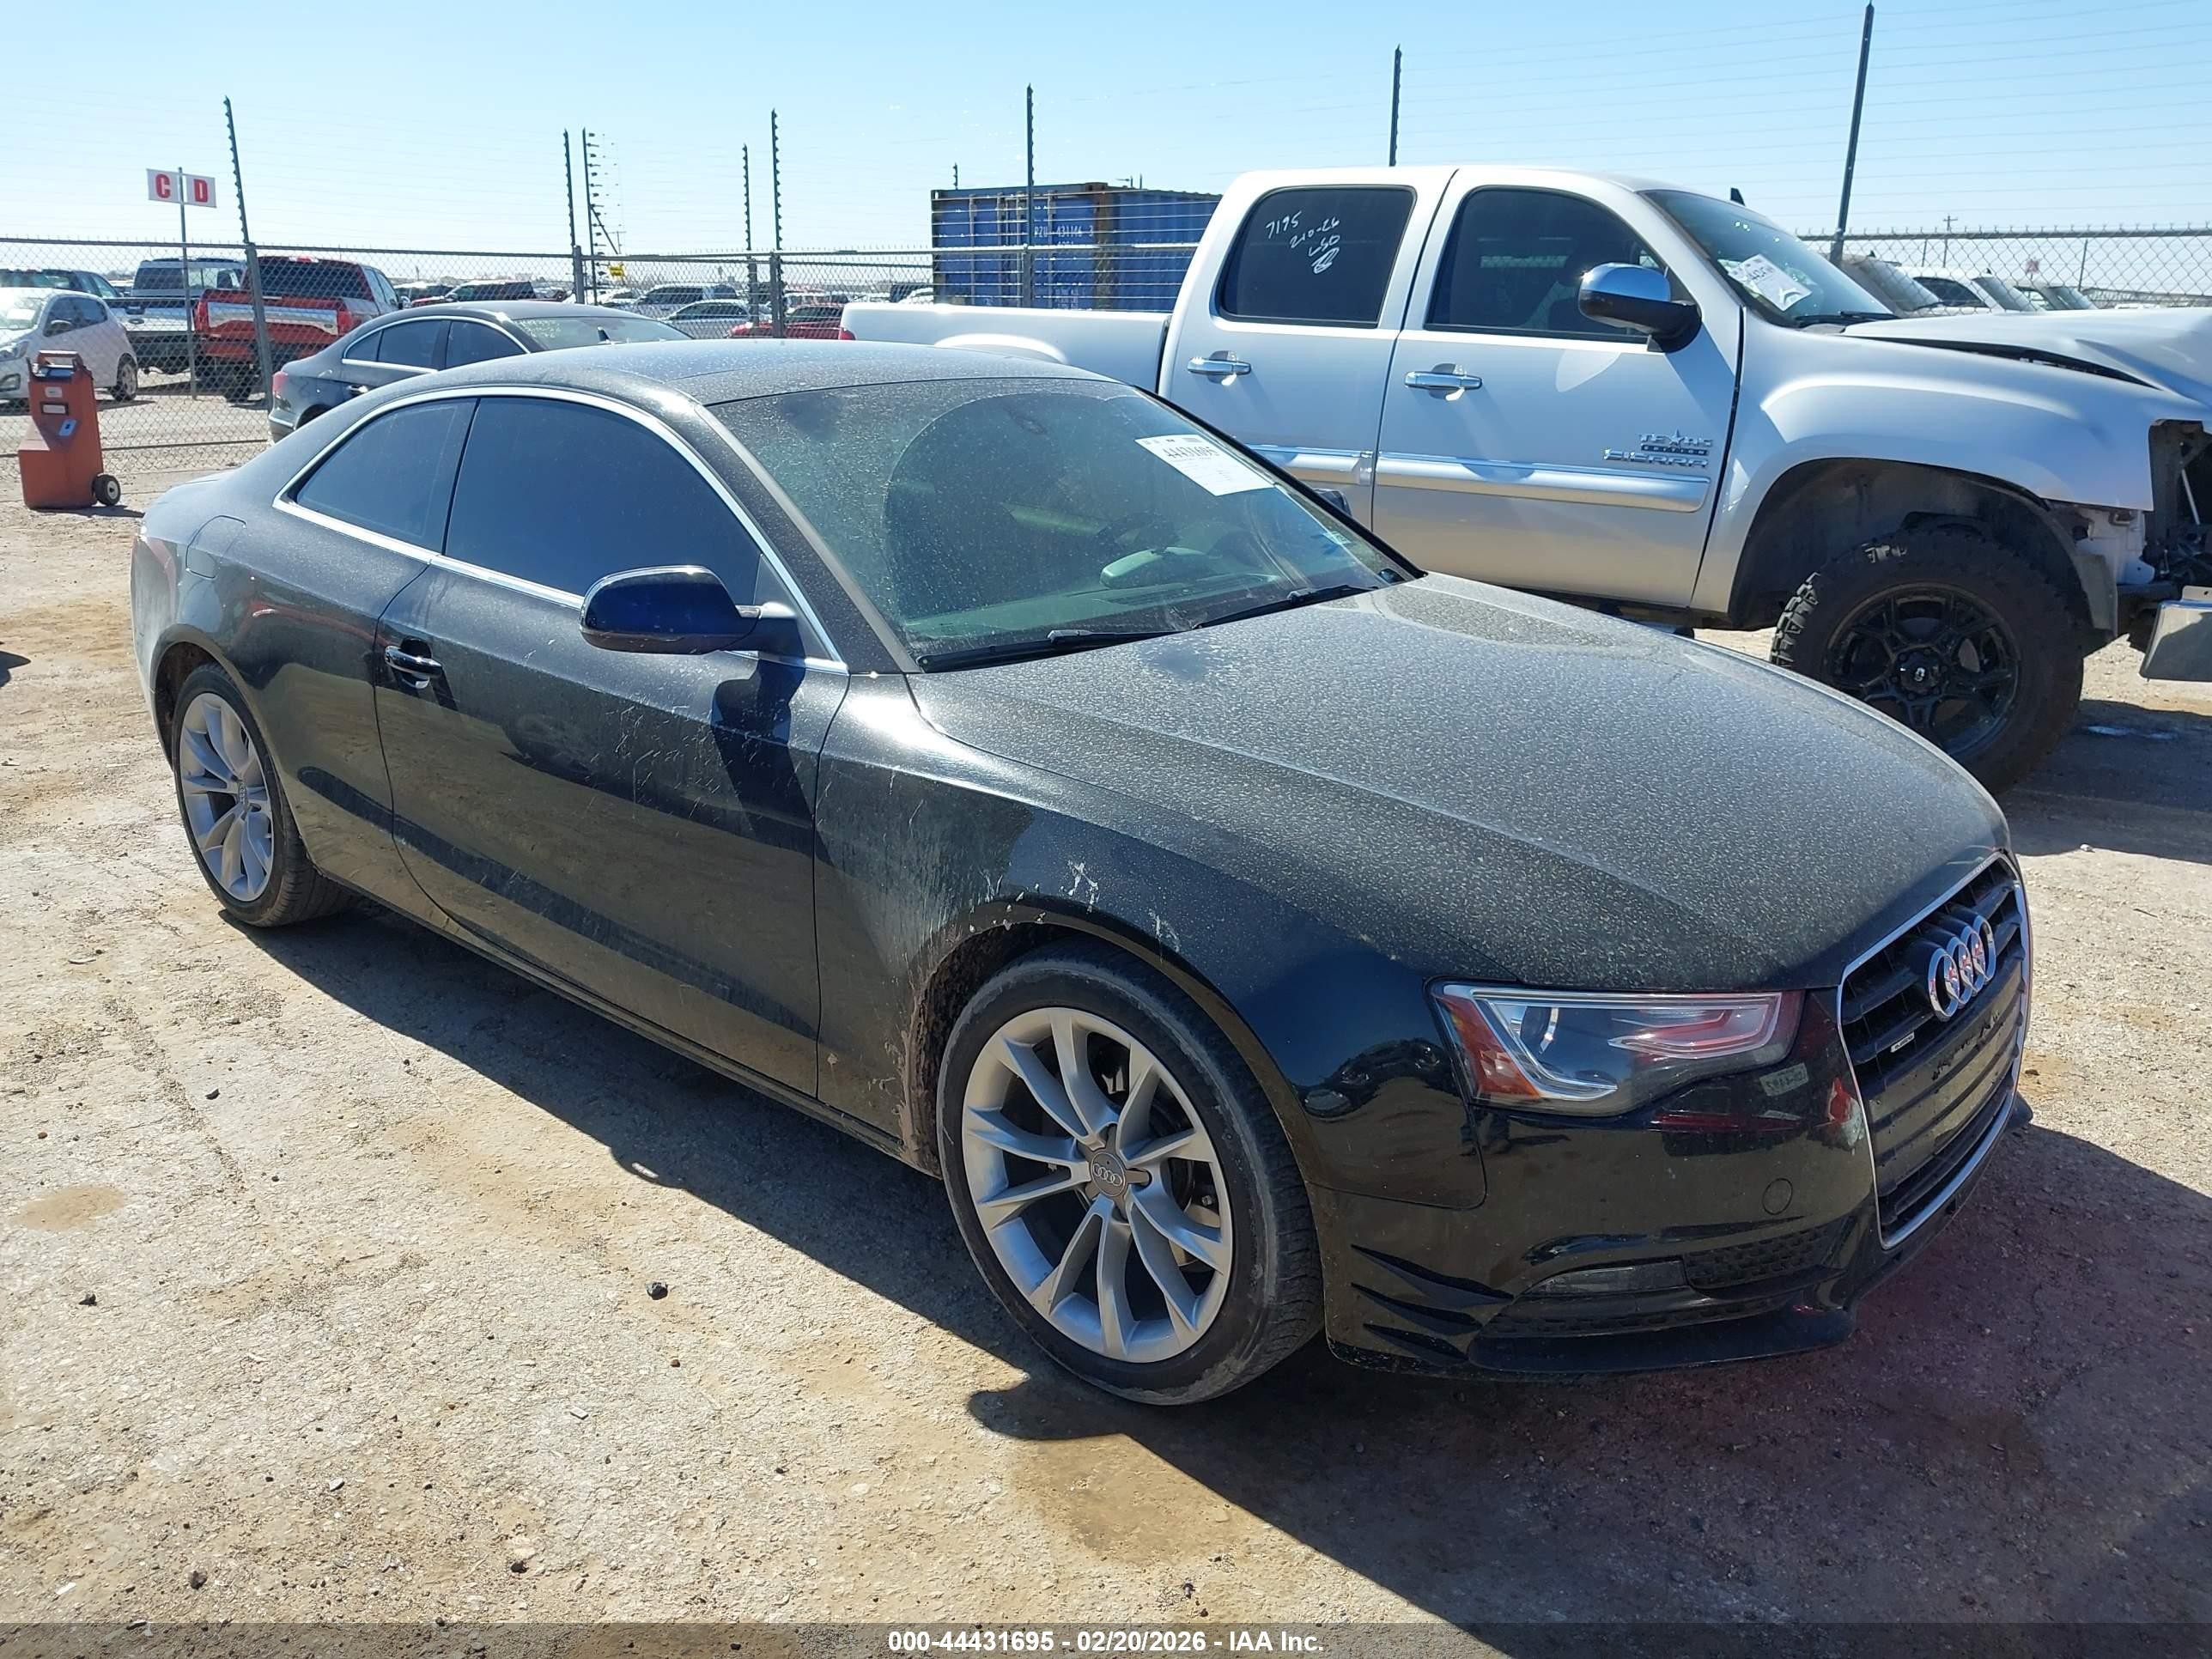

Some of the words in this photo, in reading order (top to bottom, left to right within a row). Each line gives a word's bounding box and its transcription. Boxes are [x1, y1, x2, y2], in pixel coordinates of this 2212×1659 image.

[155, 173, 171, 198] C
[193, 179, 208, 203] D
[1266, 210, 1302, 239] 7195
[1603, 449, 1709, 467] SIERRA
